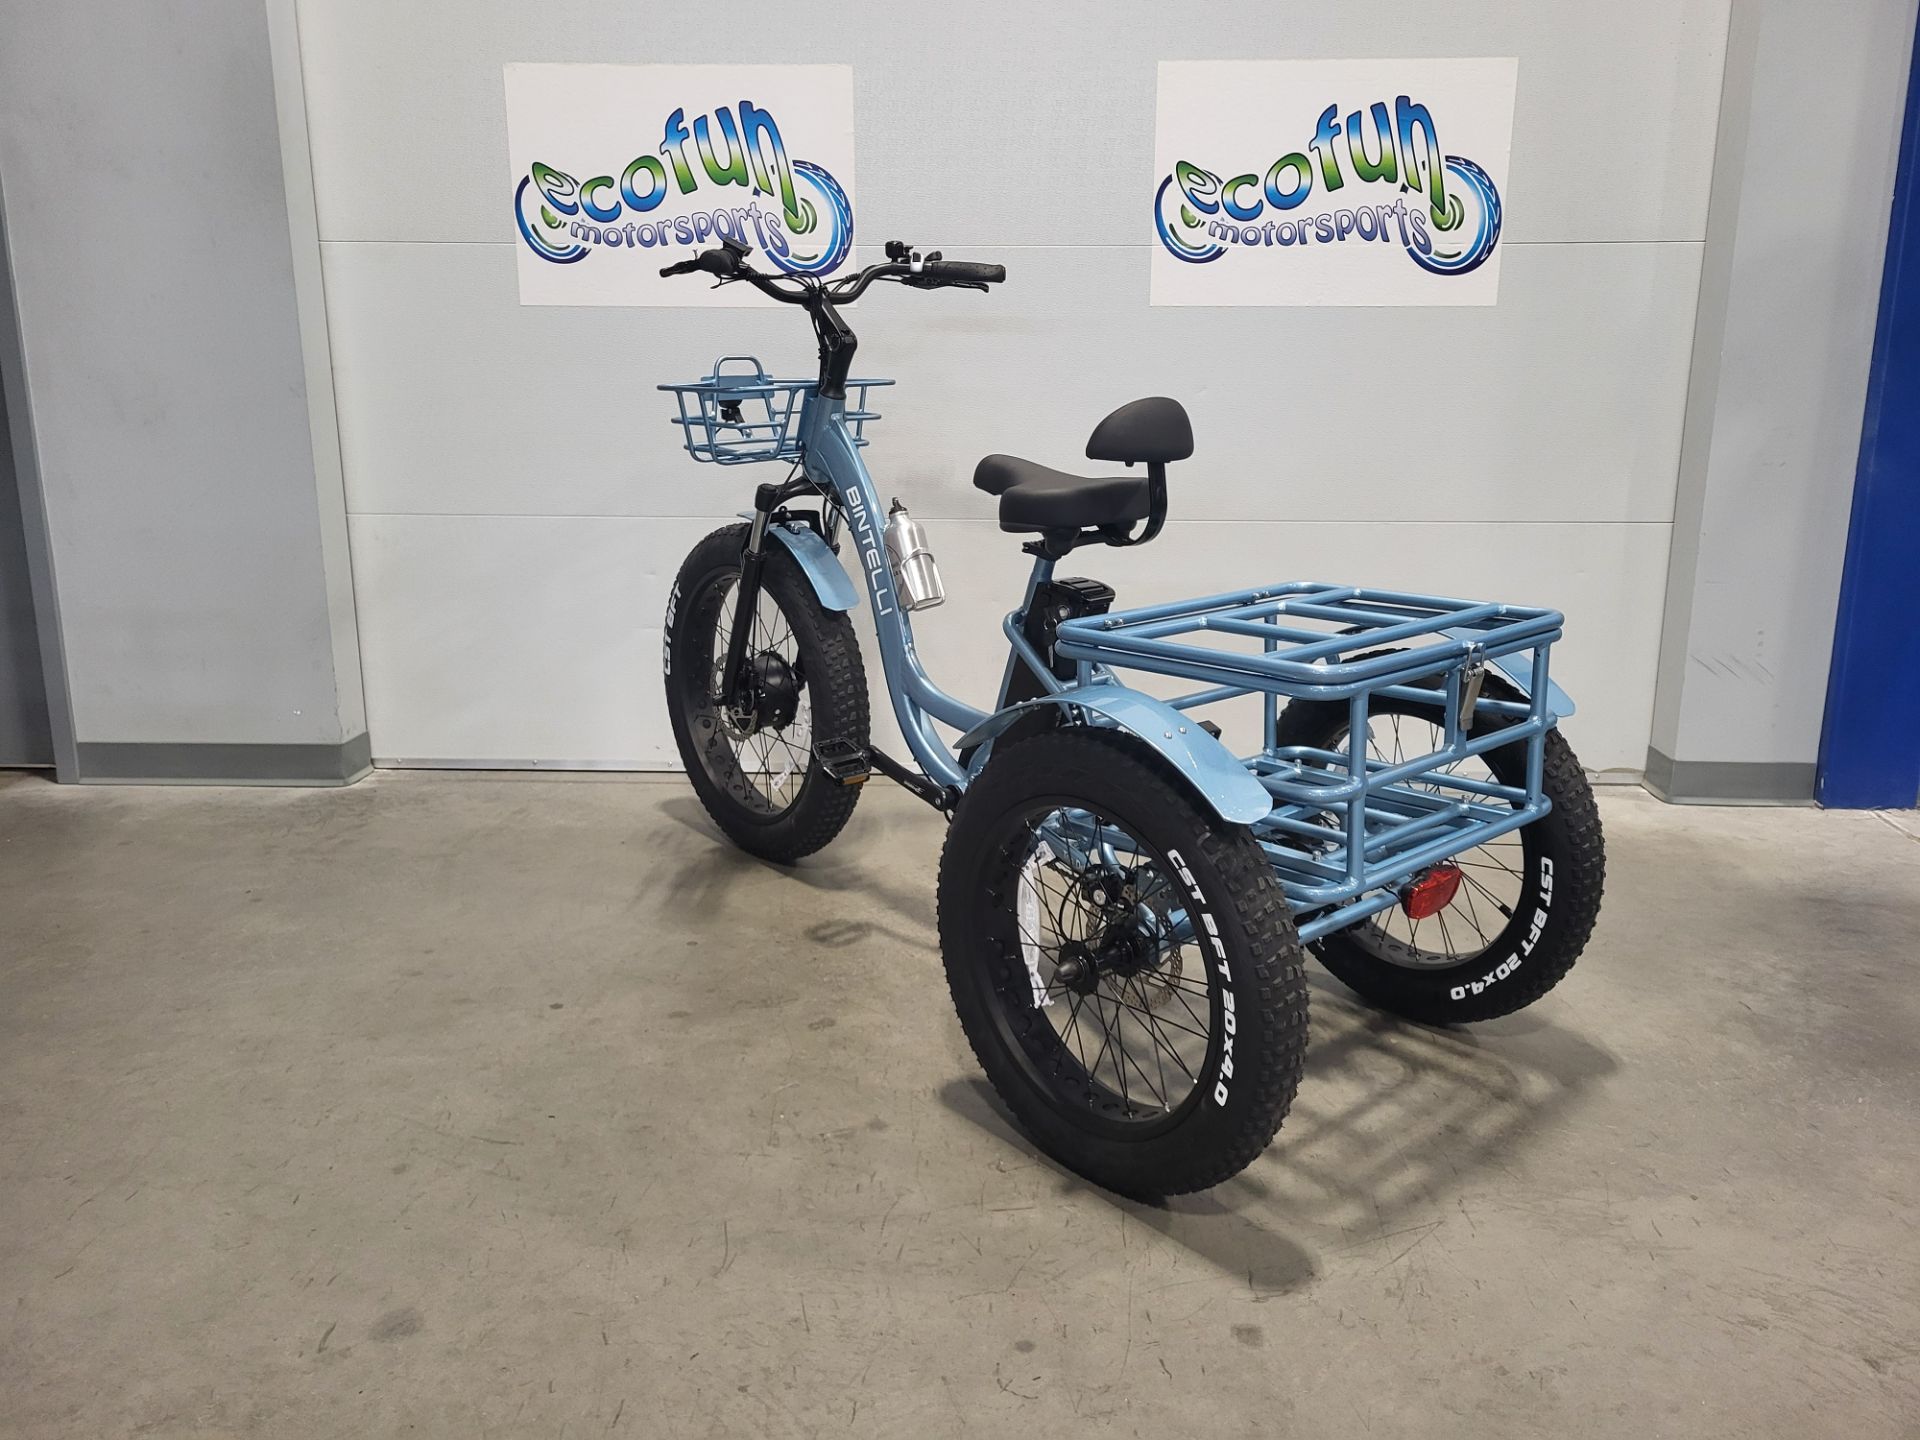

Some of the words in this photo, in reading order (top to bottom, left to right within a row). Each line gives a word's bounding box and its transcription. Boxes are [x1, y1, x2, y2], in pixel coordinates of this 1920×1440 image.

[571, 202, 789, 257] motorsports
[1208, 198, 1432, 255] motorsports
[845, 485, 893, 616] BINTELLI
[666, 582, 682, 629] BFT
[663, 629, 672, 676] CST
[1539, 856, 1554, 908] CST
[1167, 848, 1206, 905] CST
[1201, 912, 1232, 983] BFT
[1521, 909, 1549, 957] BFT
